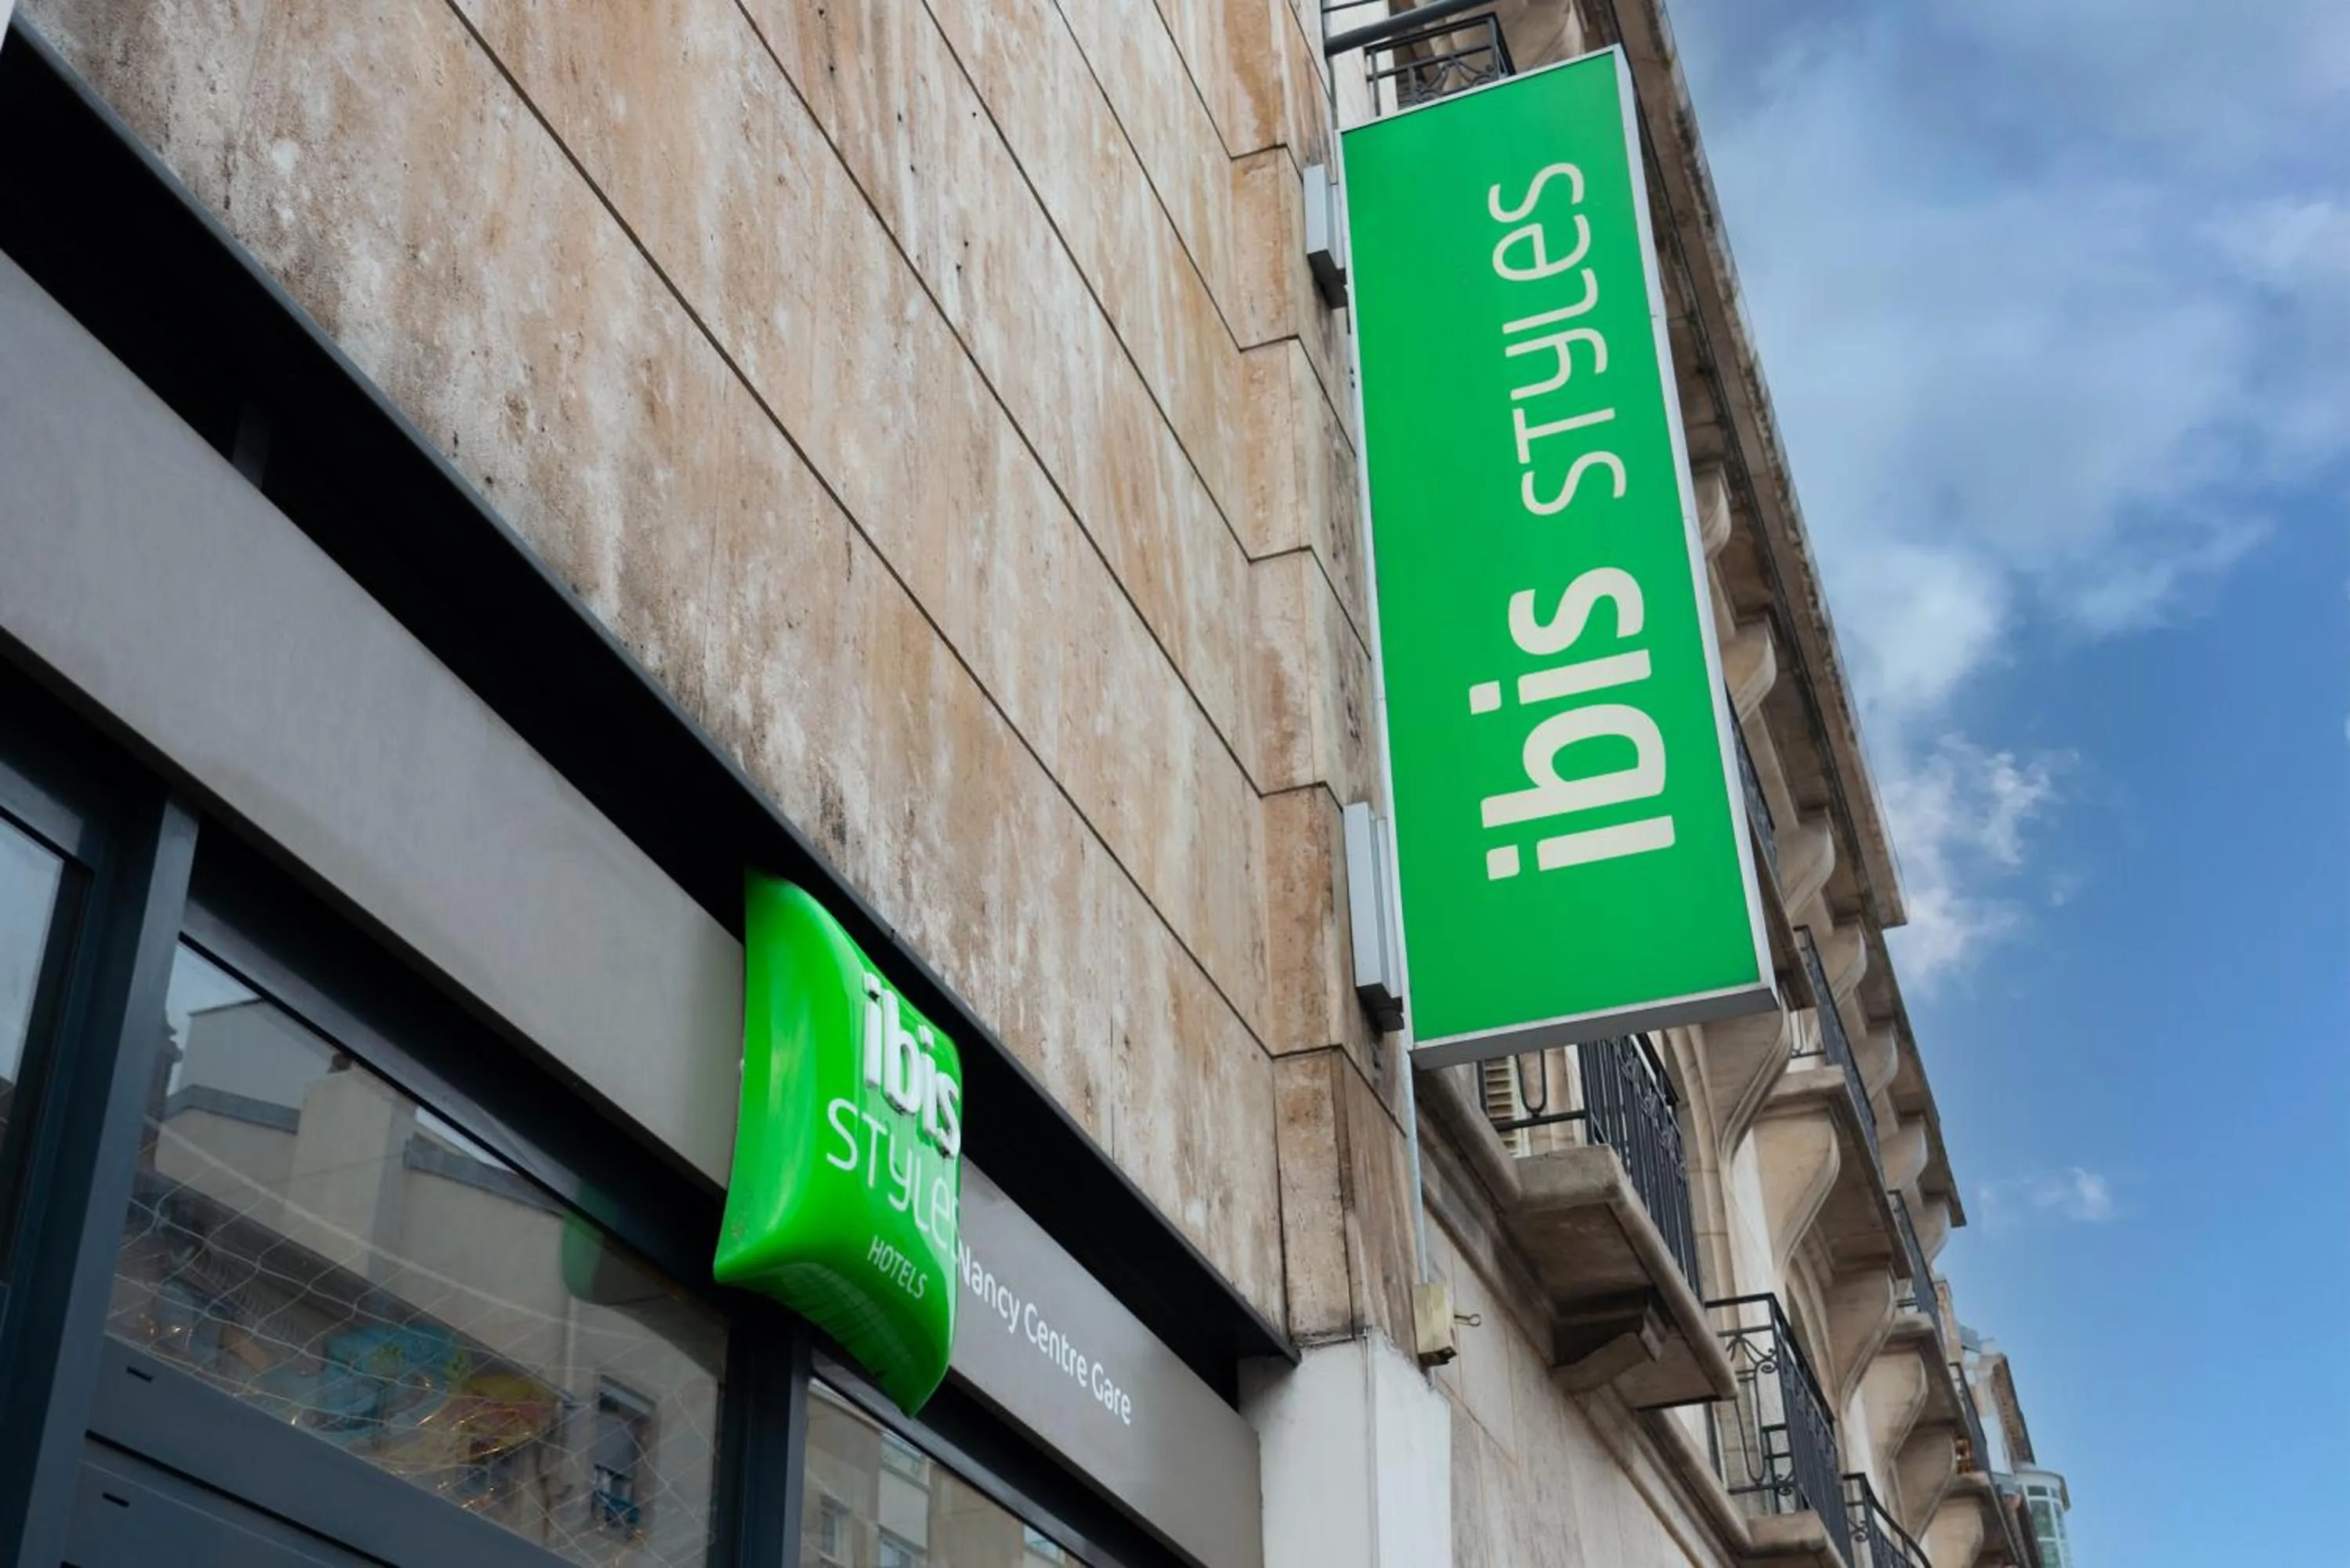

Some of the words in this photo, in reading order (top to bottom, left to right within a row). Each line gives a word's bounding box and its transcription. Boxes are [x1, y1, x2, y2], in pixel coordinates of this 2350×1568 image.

[1469, 566, 1676, 881] ibis
[863, 972, 961, 1158] ibis
[867, 1234, 928, 1299] HOTELS
[958, 1236, 1020, 1334] Nancy
[1024, 1302, 1087, 1388] Centre
[1091, 1362, 1131, 1425] Gare
